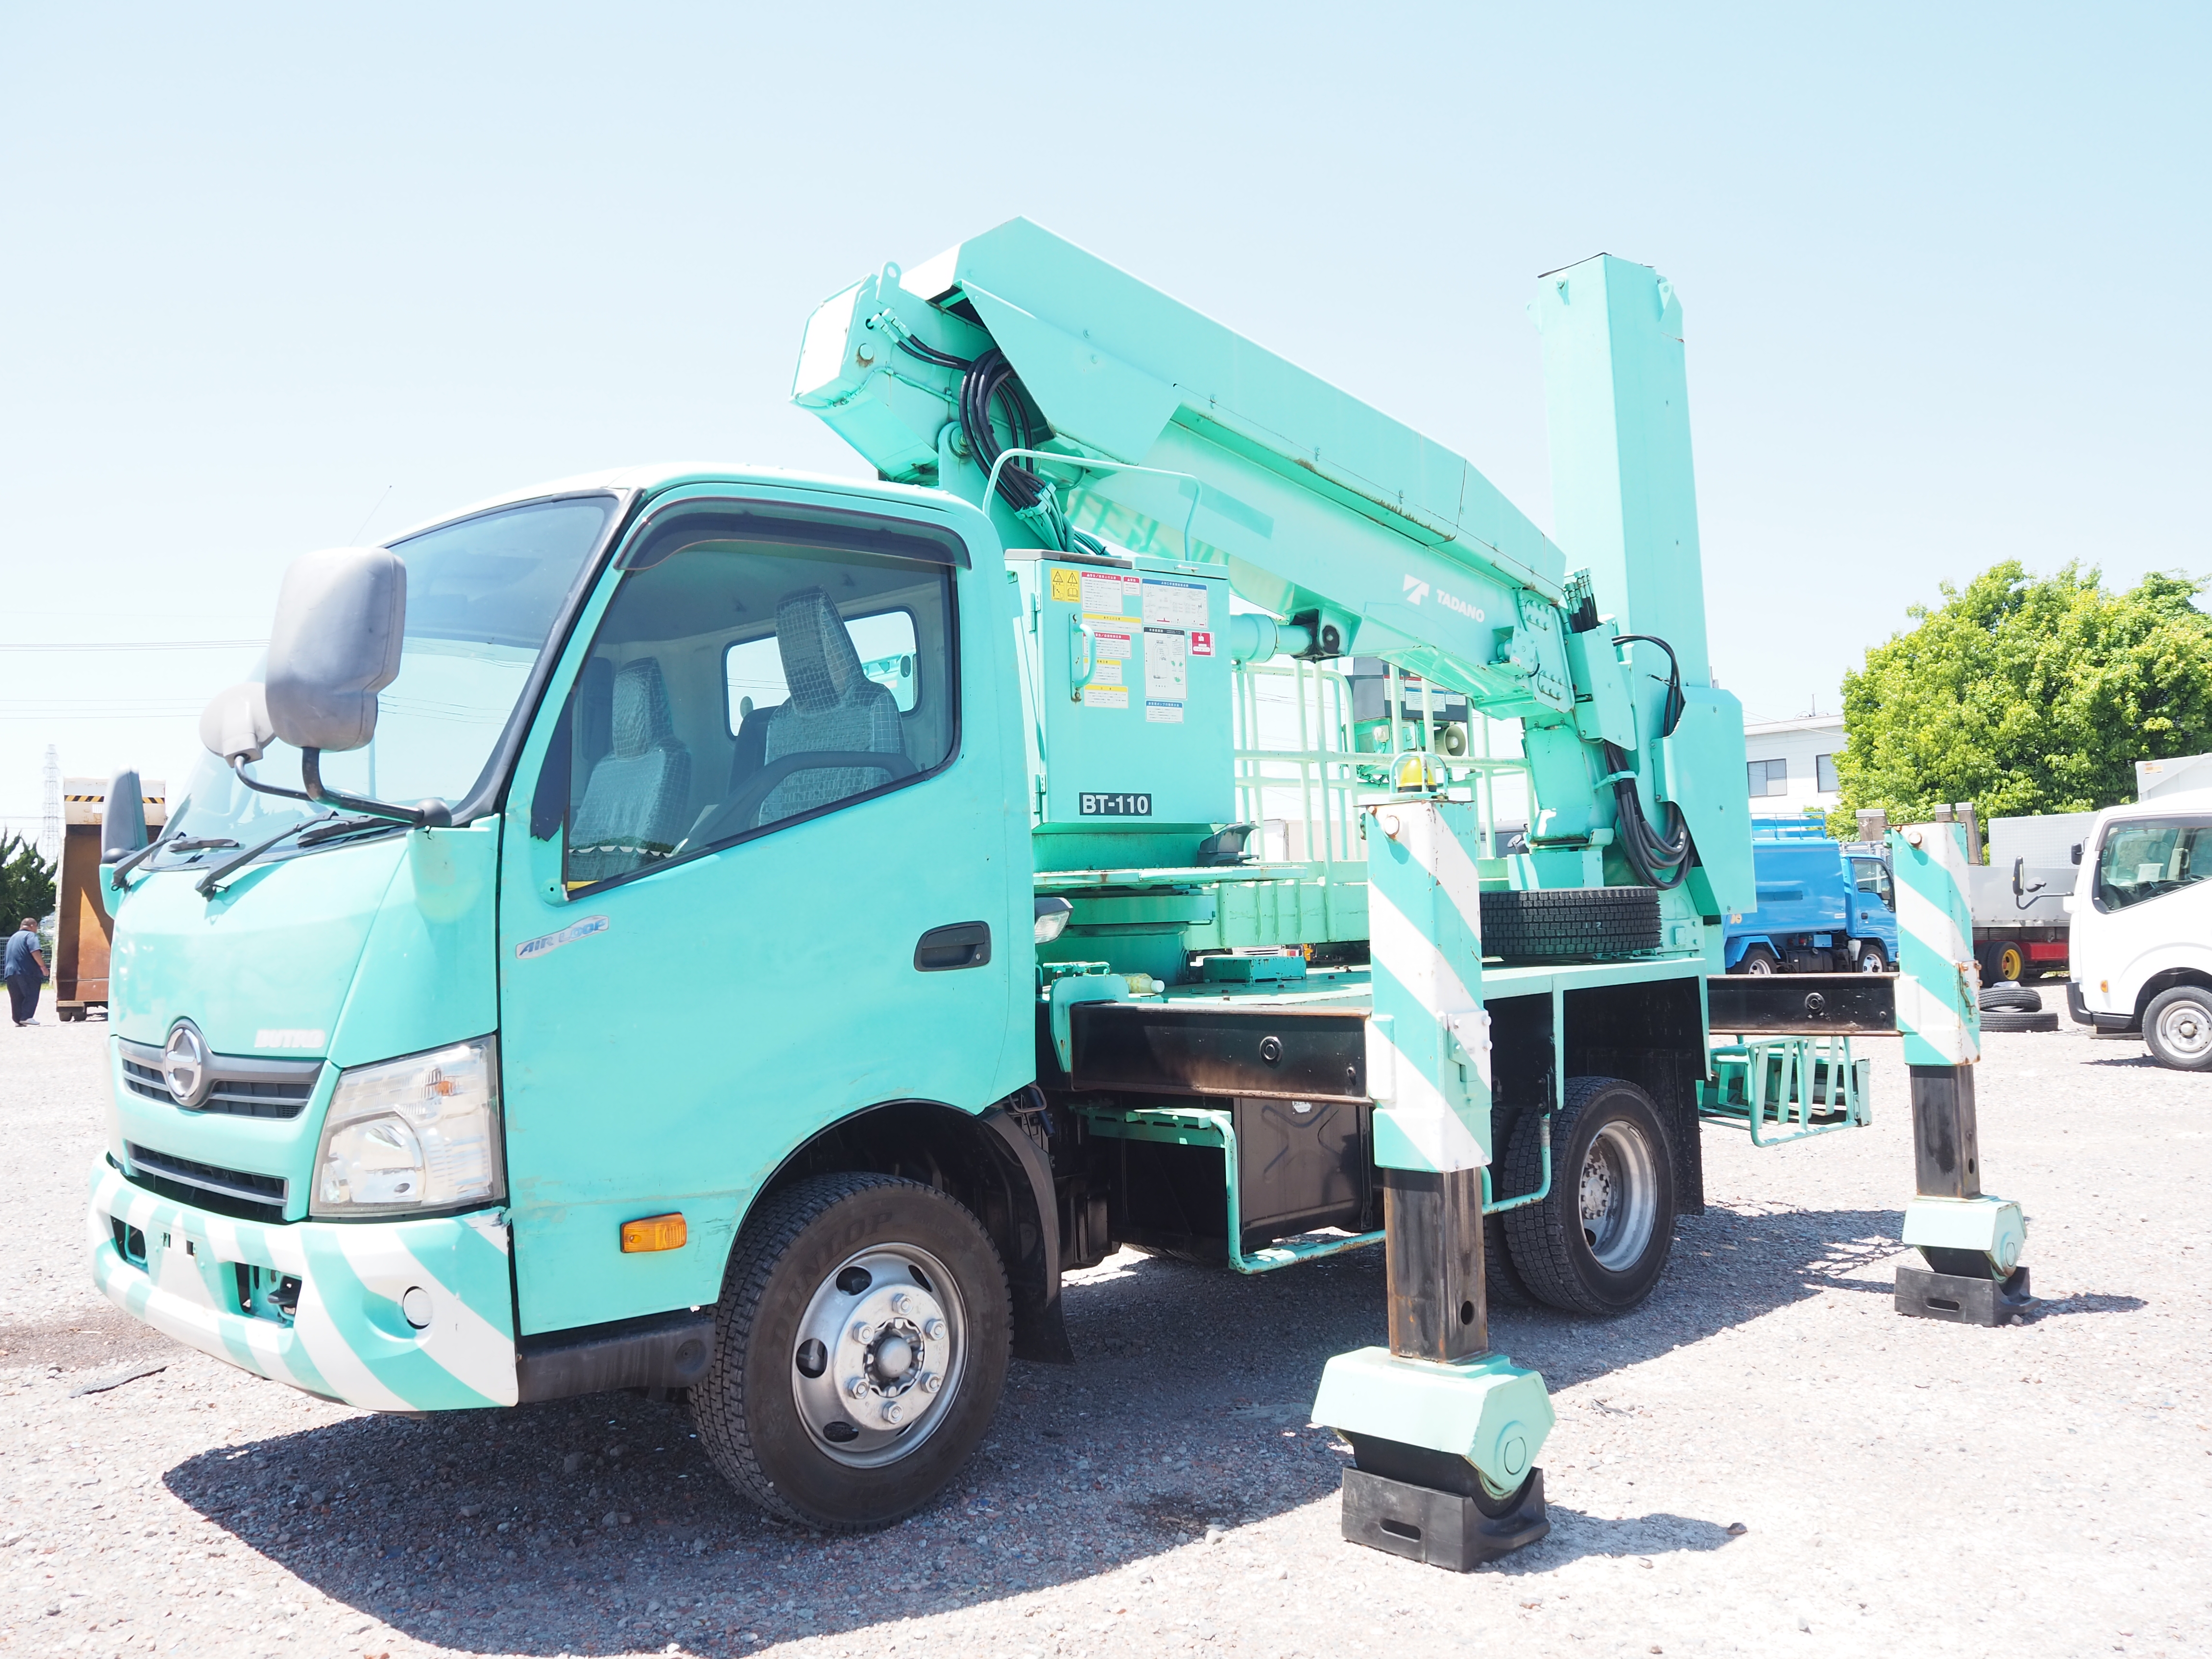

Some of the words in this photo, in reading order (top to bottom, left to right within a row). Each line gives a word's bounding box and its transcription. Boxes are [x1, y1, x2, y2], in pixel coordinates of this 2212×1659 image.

[1436, 589, 1485, 623] TADANO
[1082, 794, 1148, 814] BT-110
[519, 936, 554, 956] AIR
[558, 919, 606, 943] LOOP
[254, 1029, 325, 1048] DUTRO
[770, 1212, 892, 1354] DUNLOP
